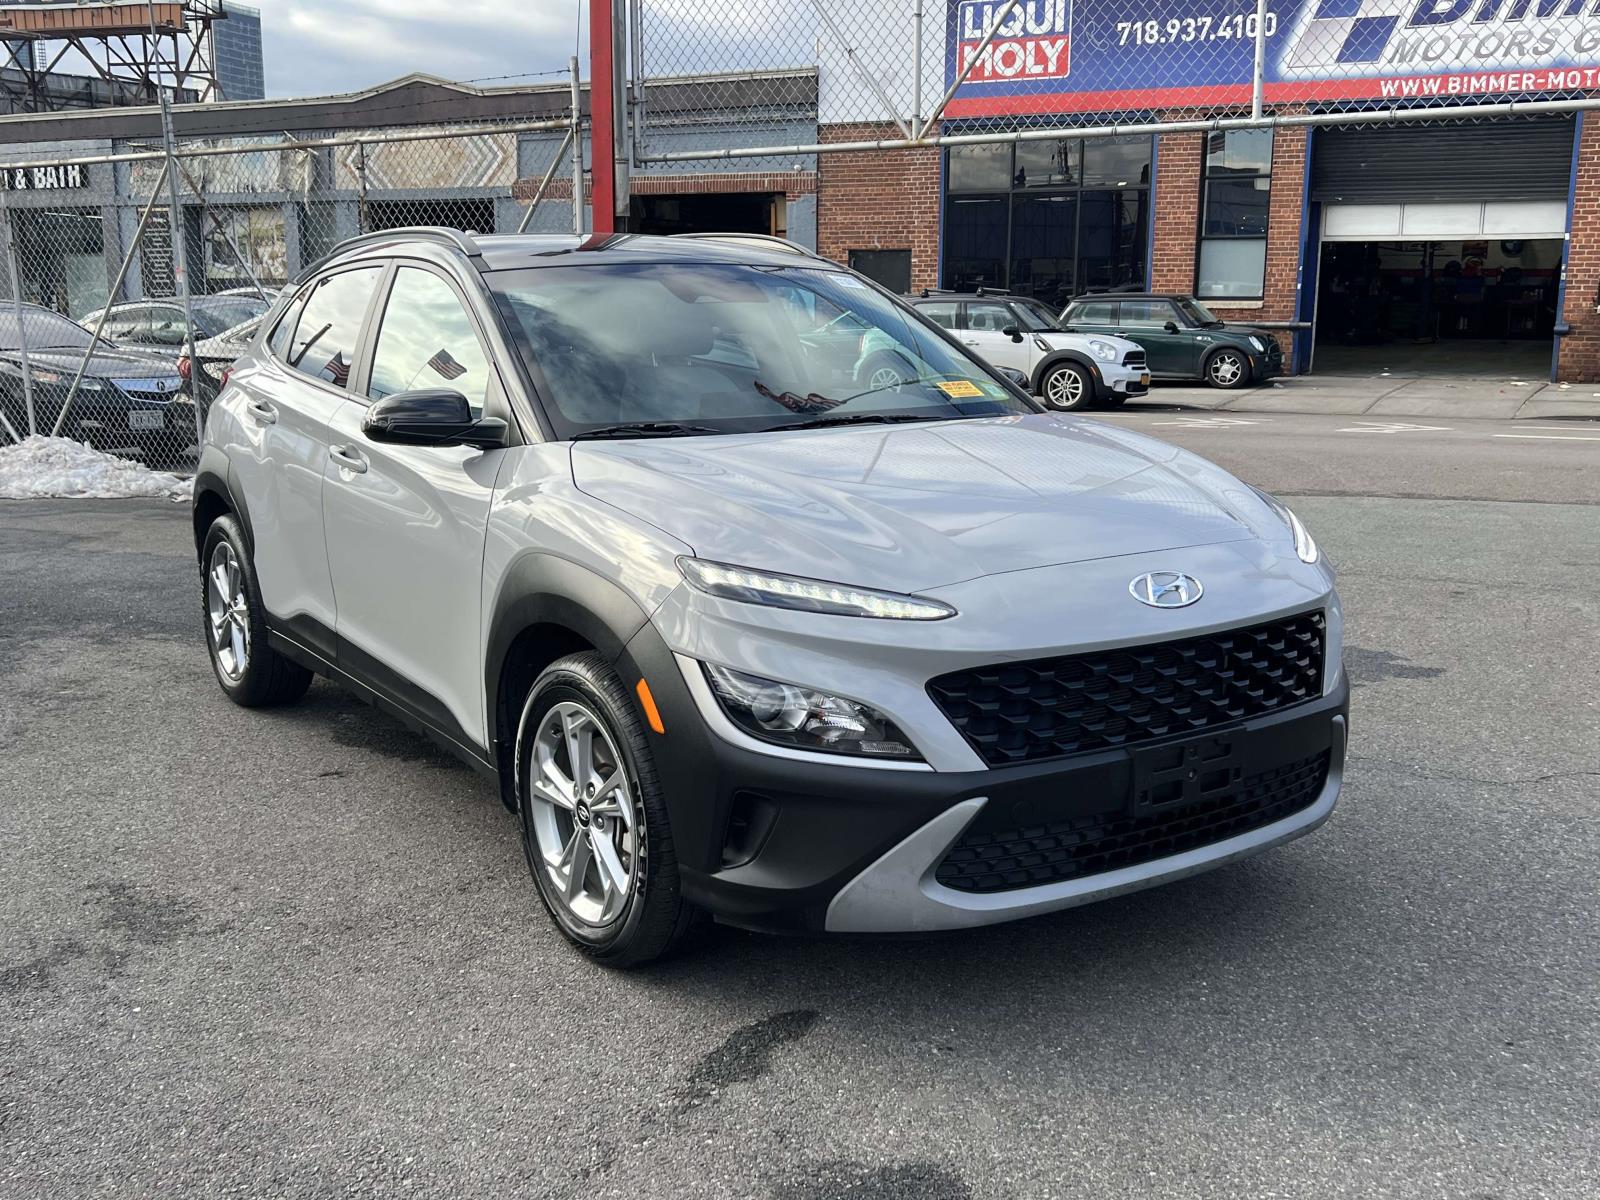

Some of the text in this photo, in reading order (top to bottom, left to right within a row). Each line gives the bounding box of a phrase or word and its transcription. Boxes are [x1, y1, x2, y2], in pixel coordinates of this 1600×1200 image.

[964, 0, 1065, 38] LIQUI
[1116, 12, 1278, 46] 718.937.4100
[963, 39, 1067, 78] MOLY
[1389, 28, 1562, 64] MOTORS
[1380, 69, 1600, 97] WWW.BIMMER-MOT
[15, 168, 27, 190] &
